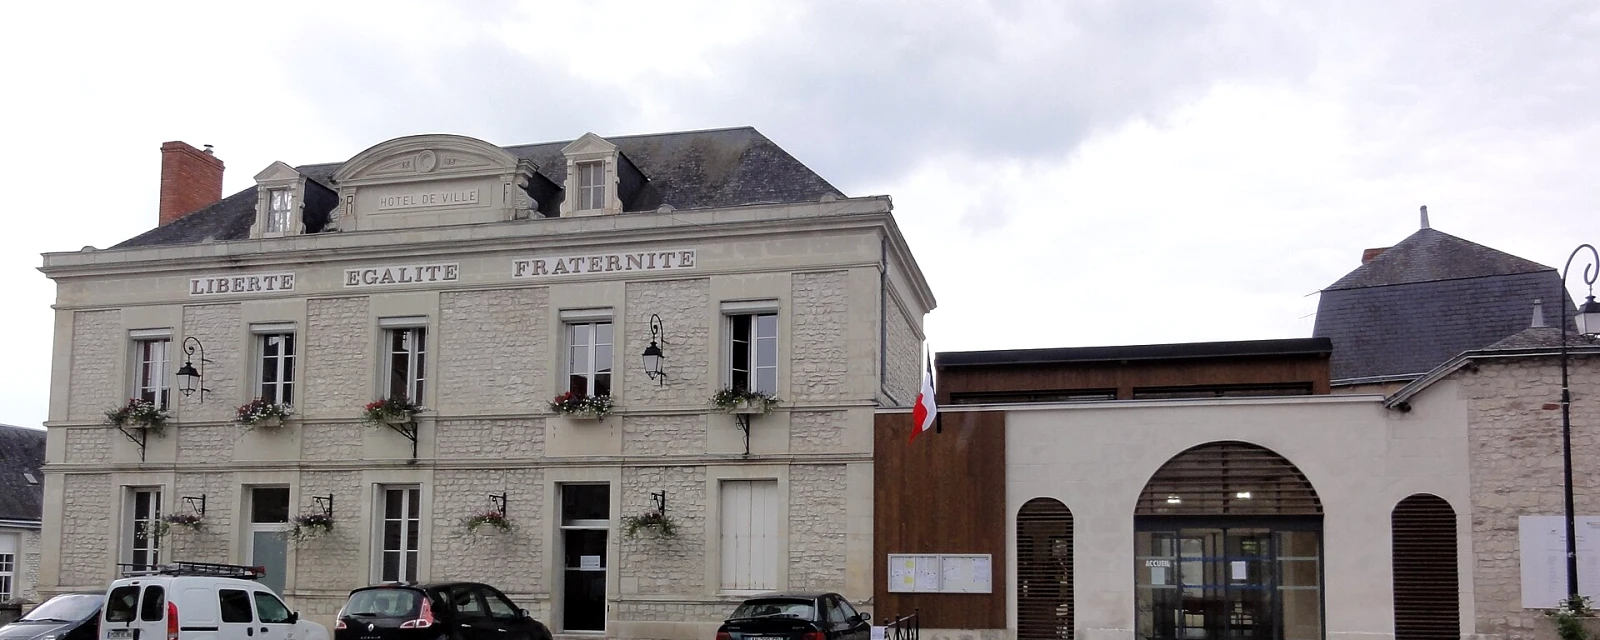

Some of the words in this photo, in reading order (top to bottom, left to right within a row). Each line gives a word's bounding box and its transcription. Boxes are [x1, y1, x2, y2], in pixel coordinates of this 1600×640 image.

[345, 195, 354, 215] R
[380, 195, 417, 208] HOTEL
[422, 193, 436, 205] DE
[442, 190, 477, 203] VILLE
[514, 250, 695, 278] FRATERNITE
[190, 274, 295, 296] LIBERTE
[345, 264, 459, 287] EGALITE
[1145, 560, 1171, 568] ACCUEIL
